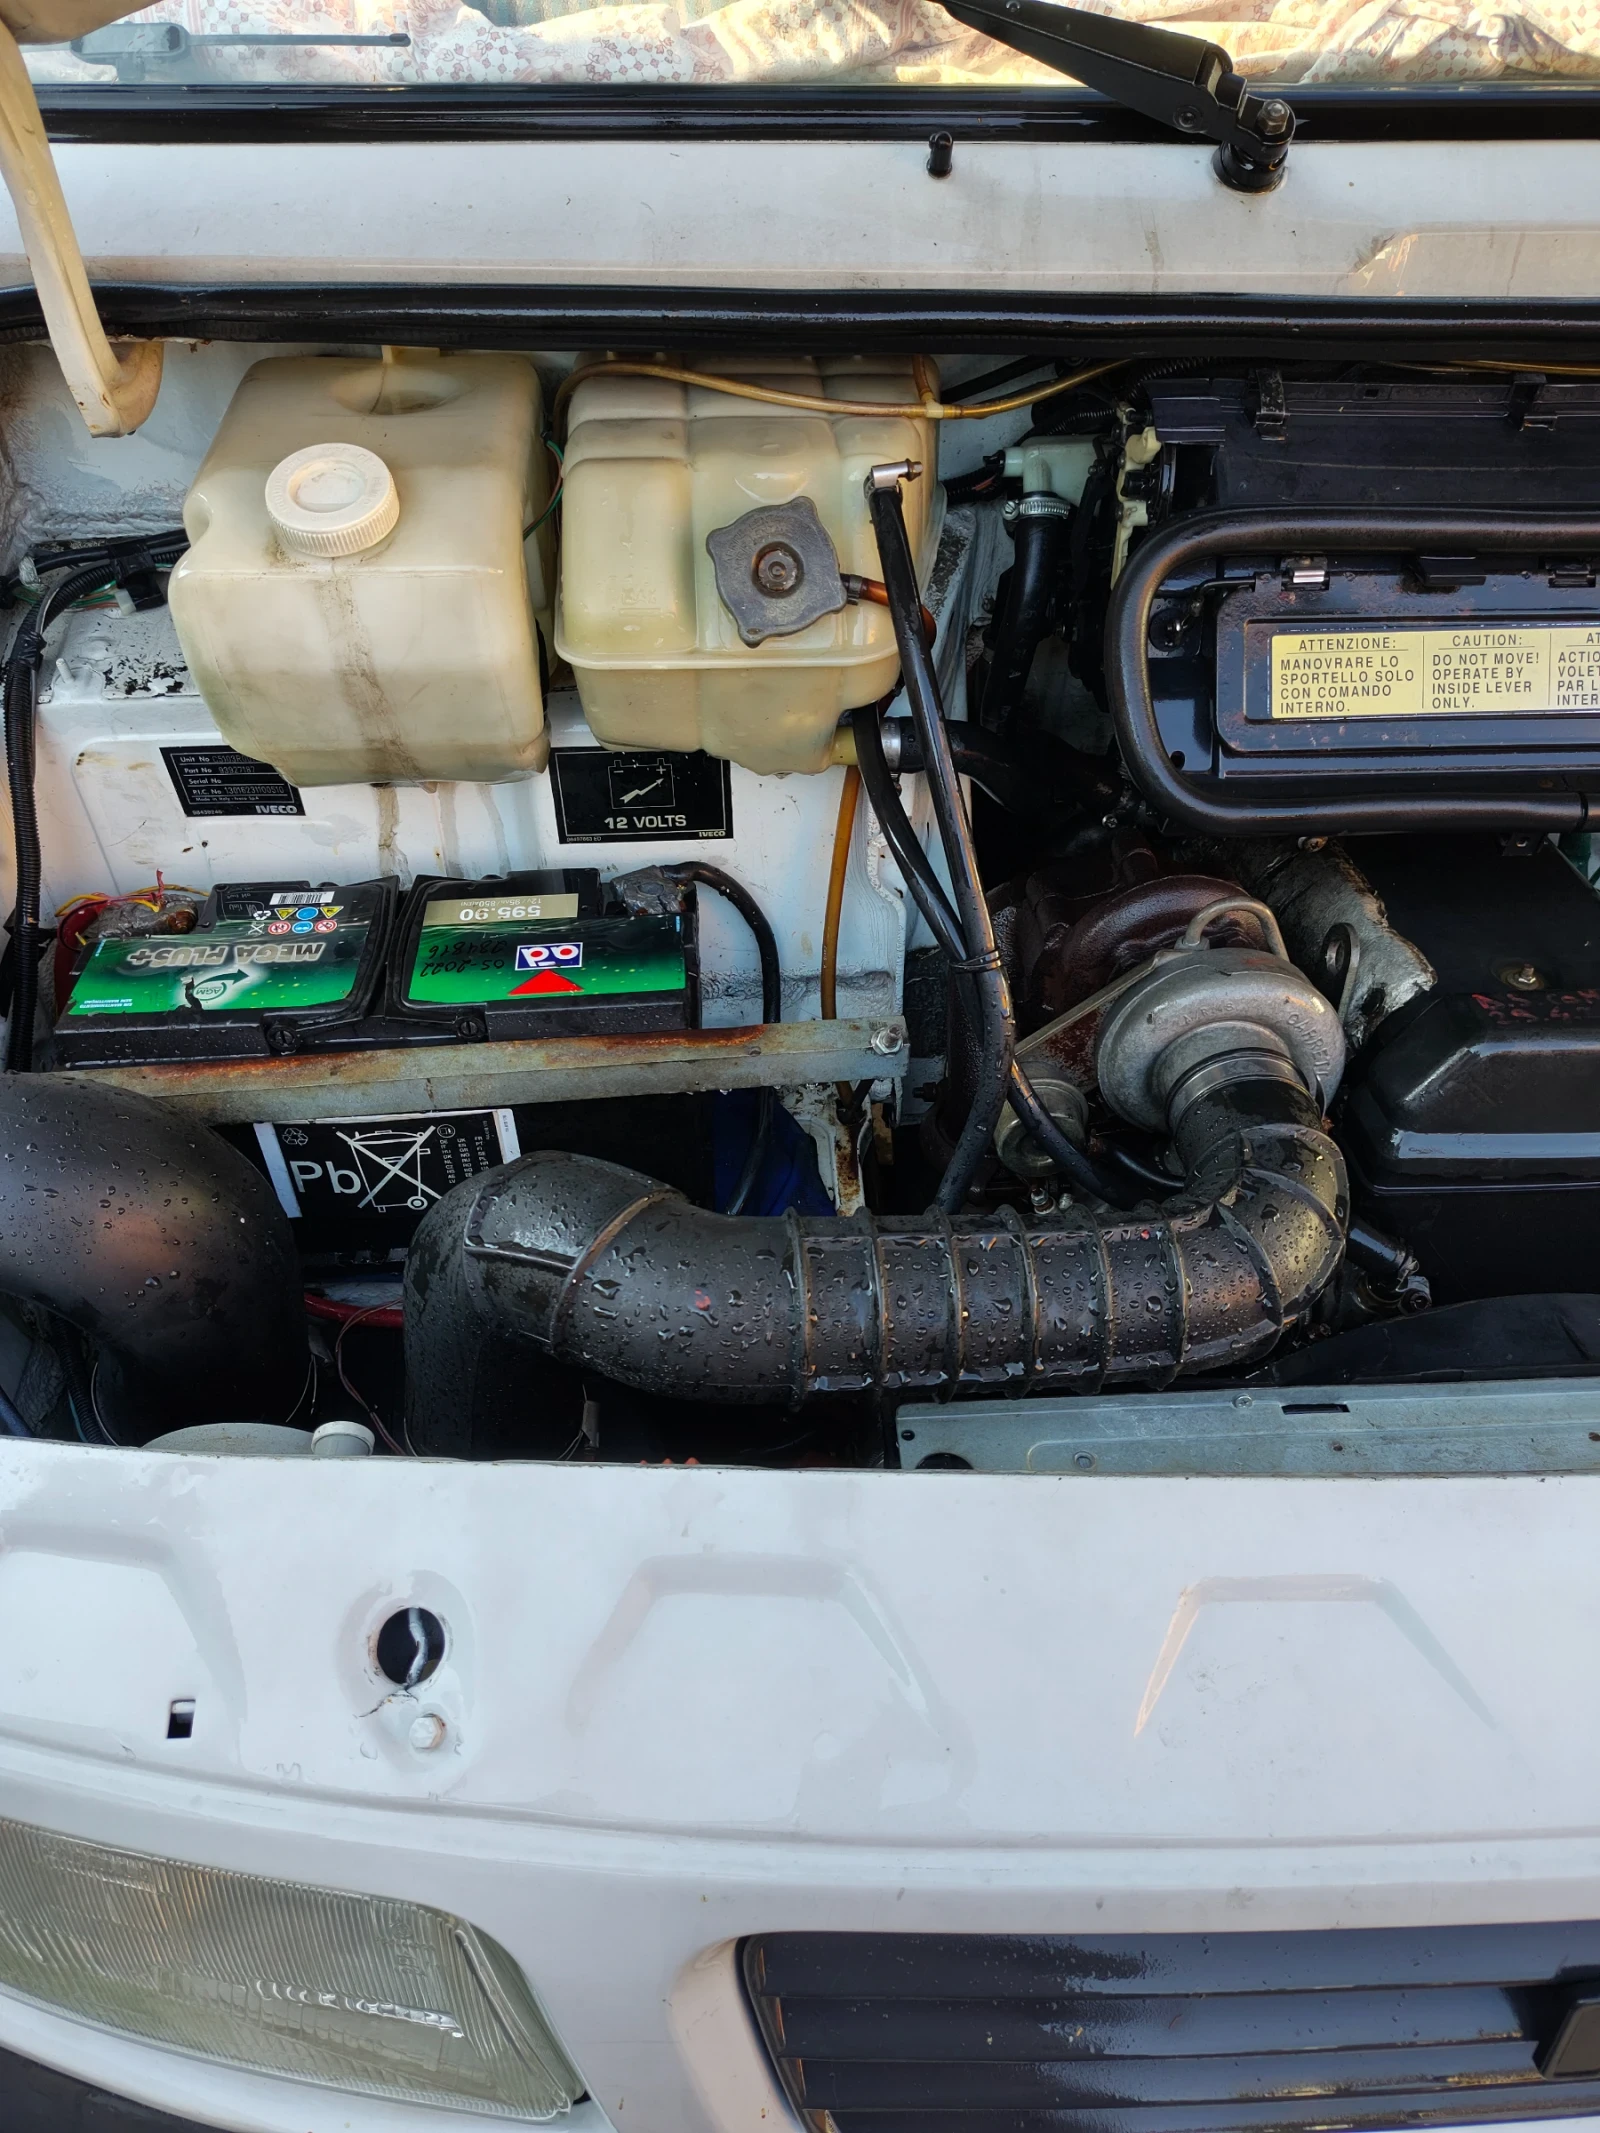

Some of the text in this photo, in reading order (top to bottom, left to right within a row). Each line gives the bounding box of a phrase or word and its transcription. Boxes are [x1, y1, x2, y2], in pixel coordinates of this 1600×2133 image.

[1299, 637, 1396, 651] ATTENZIONE:
[1452, 634, 1522, 647] CAUTION:
[1280, 655, 1399, 671] MANOVRARE LO
[1432, 652, 1540, 666] DO NOT MOVE!
[1558, 651, 1600, 663] ACTIO
[1280, 669, 1414, 685] SPORTELLO SOLO
[1432, 667, 1524, 681] OPERATE BY
[1280, 685, 1391, 700] CON COMANDO
[1432, 681, 1532, 695] INSIDE LEVER
[1557, 680, 1584, 692] PAR
[1432, 697, 1475, 709] ONLY.
[1557, 694, 1599, 706] INTER
[1280, 701, 1350, 714] INTERNO.
[255, 805, 298, 814] IVECO
[604, 815, 687, 829] 12 VOLTS
[459, 905, 541, 921] 595.90
[129, 945, 228, 967] PLUS+
[235, 942, 328, 966] MEGA
[290, 1161, 361, 1194] Pb
